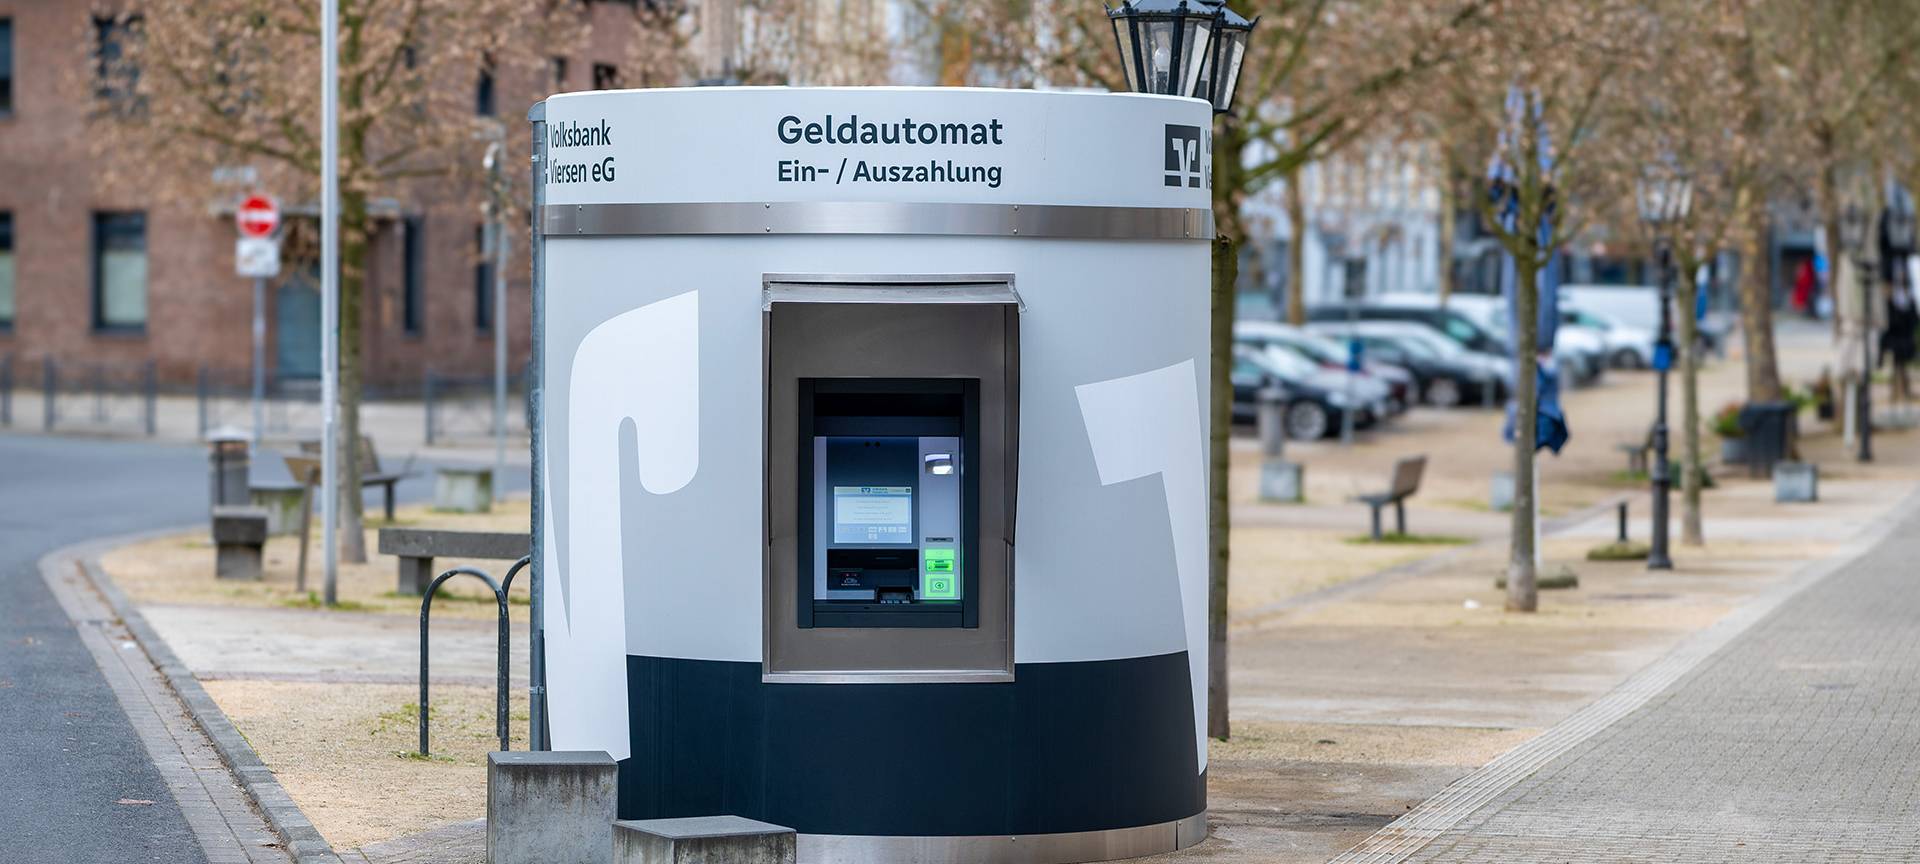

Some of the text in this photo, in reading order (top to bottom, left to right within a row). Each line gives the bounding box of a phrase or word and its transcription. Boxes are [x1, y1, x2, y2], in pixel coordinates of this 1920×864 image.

[550, 119, 612, 148] Volksbank
[777, 114, 1003, 145] Geldautomat
[550, 156, 615, 184] Viersen eG
[778, 157, 1002, 189] Ein- / Auszahlung
